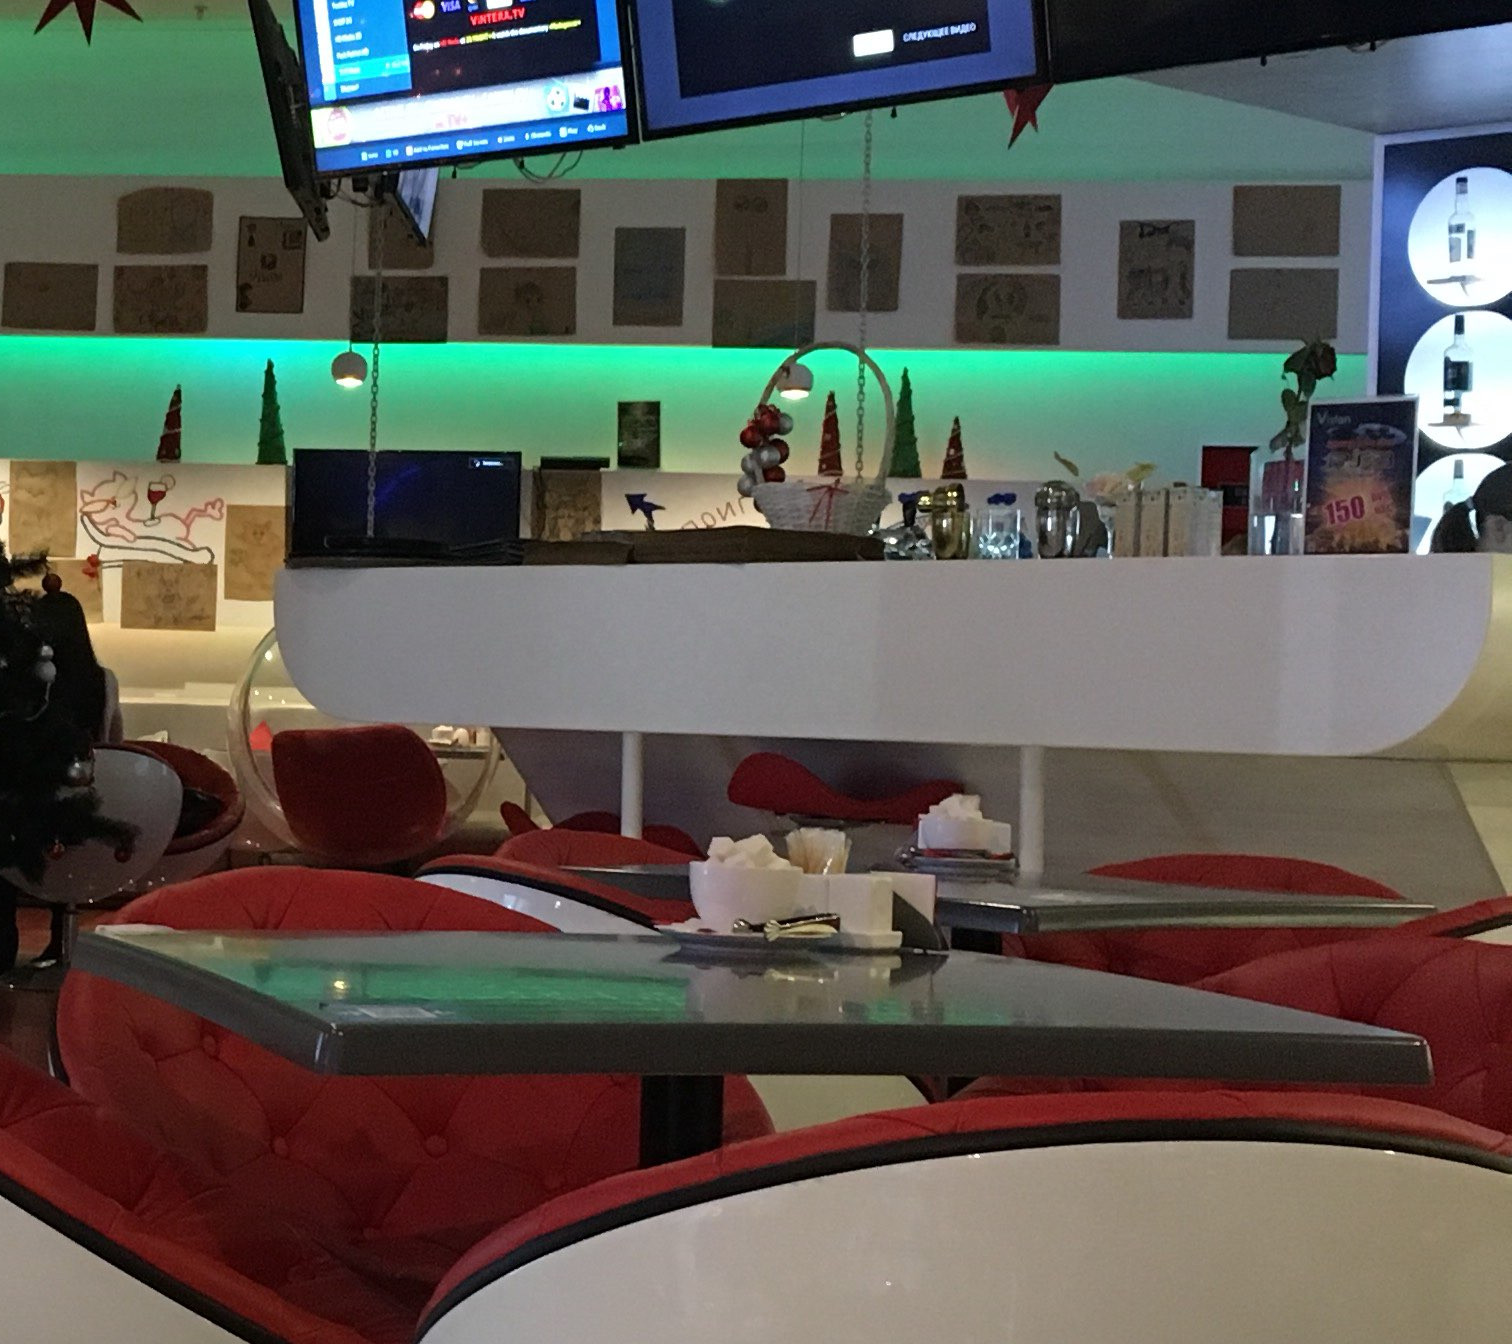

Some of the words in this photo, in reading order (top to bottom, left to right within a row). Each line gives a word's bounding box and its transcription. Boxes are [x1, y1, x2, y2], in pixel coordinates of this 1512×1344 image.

[440, 0, 461, 13] VISA
[470, 7, 526, 26] VINTERA.TV
[1325, 496, 1365, 525] 150
